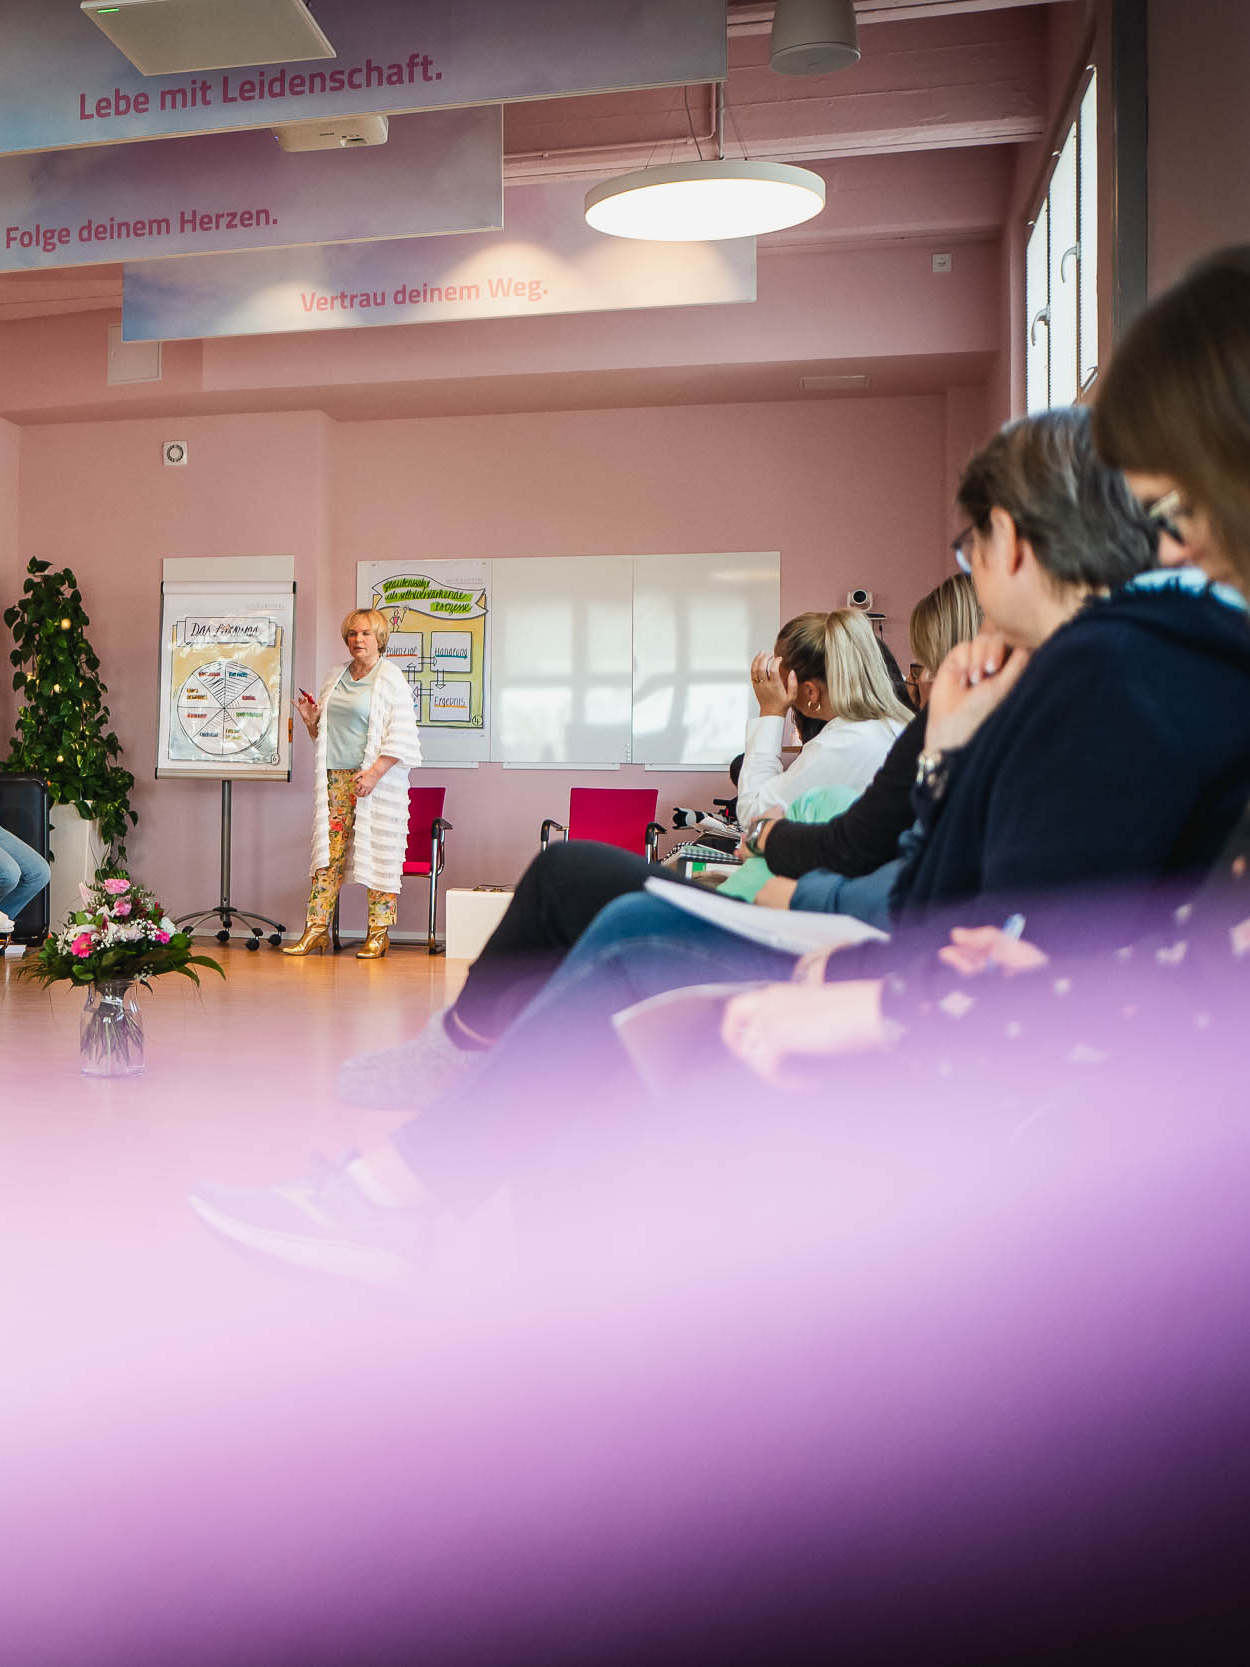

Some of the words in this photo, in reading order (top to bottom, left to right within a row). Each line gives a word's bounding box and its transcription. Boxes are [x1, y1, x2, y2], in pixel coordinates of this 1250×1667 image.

[79, 88, 150, 120] Lebe
[160, 79, 212, 111] mit
[222, 53, 443, 103] Leidenschaft.
[6, 224, 70, 252] Folge
[78, 217, 170, 242] deinem
[179, 208, 278, 233] Herzen.
[301, 290, 386, 312] Vertrau
[393, 283, 480, 304] deinem
[487, 277, 548, 302] Weg.
